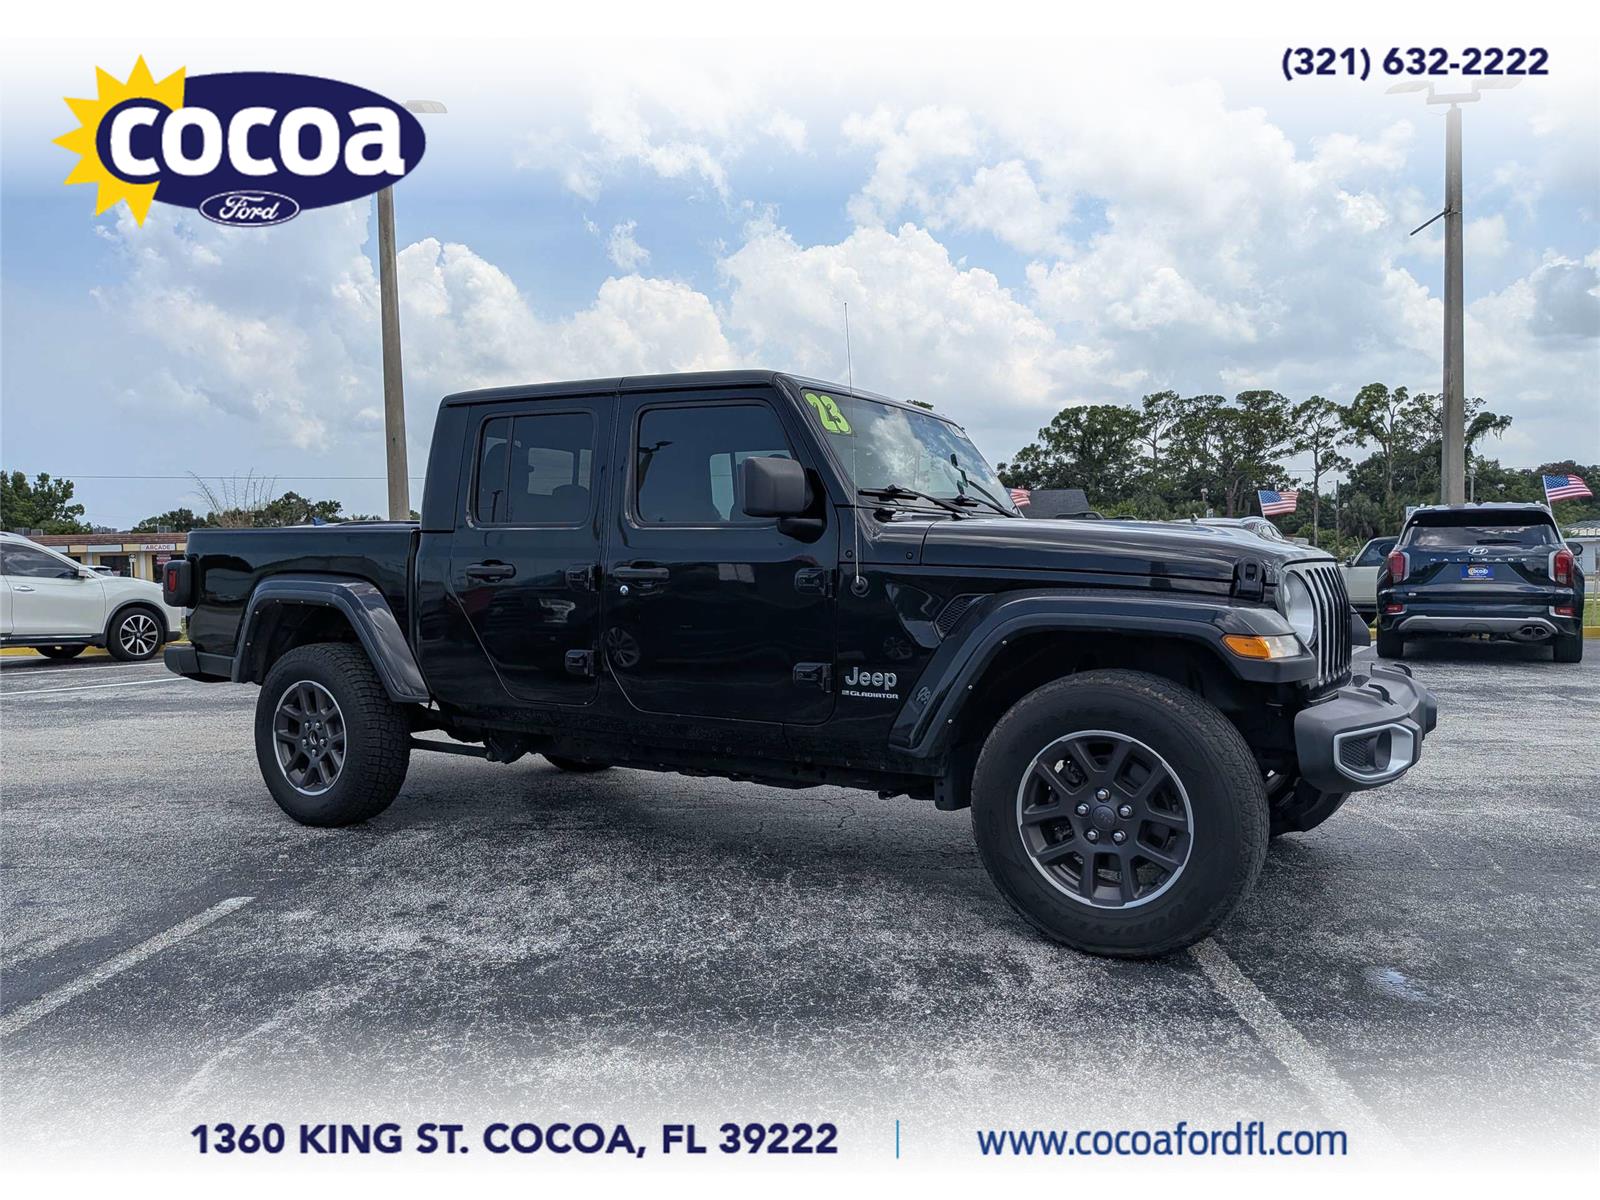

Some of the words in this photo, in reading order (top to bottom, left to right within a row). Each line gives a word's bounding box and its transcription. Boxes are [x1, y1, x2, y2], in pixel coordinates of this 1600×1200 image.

[804, 392, 851, 434] 23
[844, 667, 897, 690] Jeep
[849, 690, 898, 699] GLADIATOR
